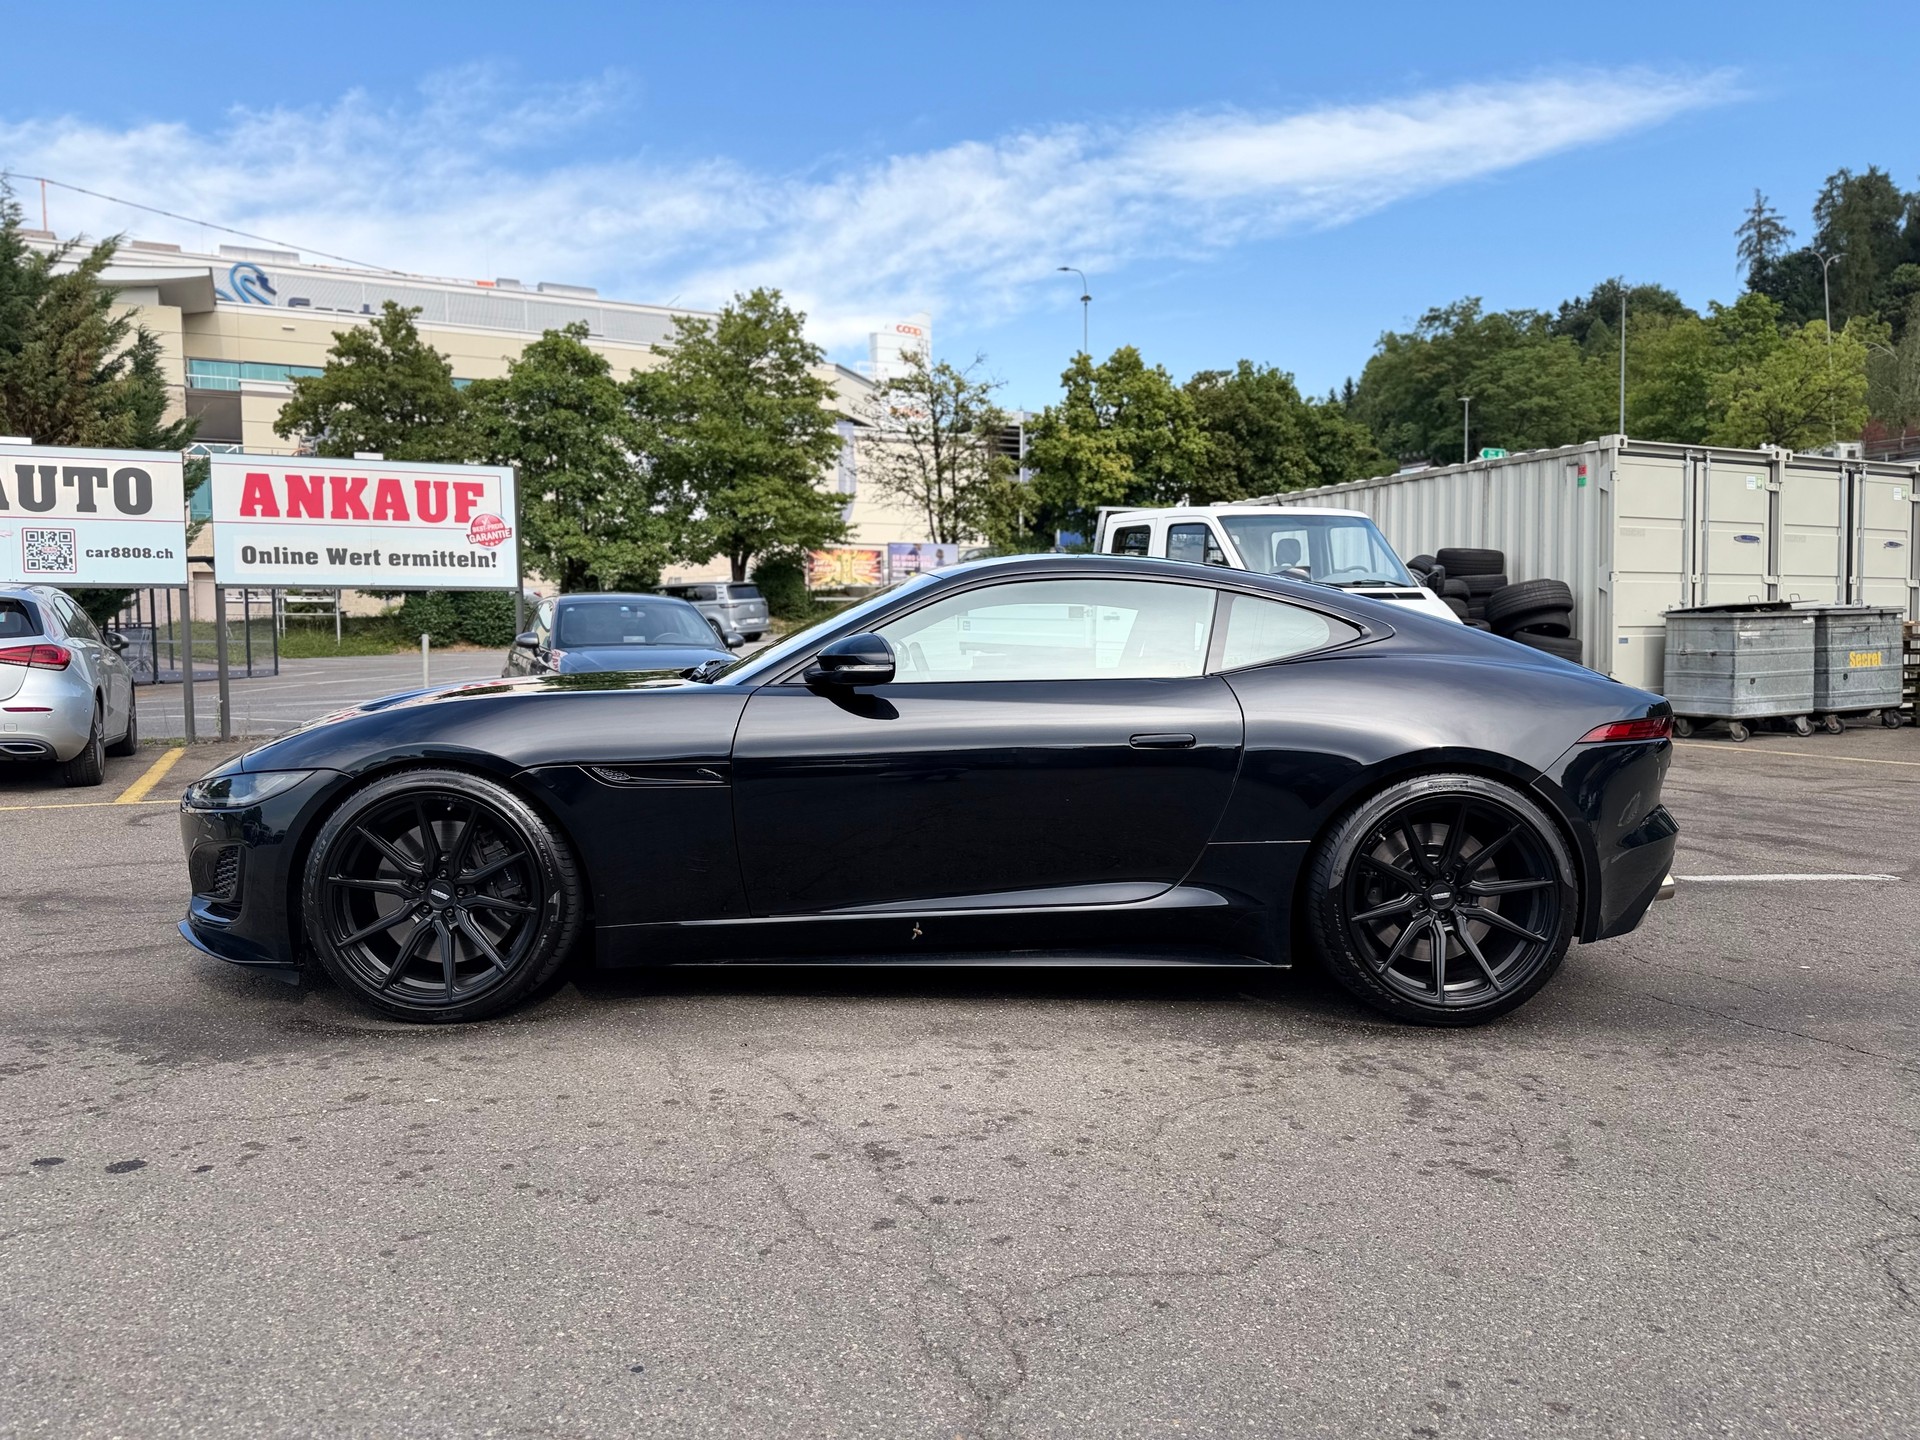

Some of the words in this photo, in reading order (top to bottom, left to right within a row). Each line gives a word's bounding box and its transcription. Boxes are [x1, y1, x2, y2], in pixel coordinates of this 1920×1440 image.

[896, 324, 922, 337] coop
[0, 464, 153, 516] UTO
[240, 473, 484, 523] ANKAUF
[469, 529, 512, 543] GARANTIE
[86, 546, 174, 559] car8808.ch
[241, 545, 318, 565] Online
[326, 548, 381, 566] Wert
[388, 550, 497, 568] ermitteln!
[1849, 651, 1882, 668] Secret
